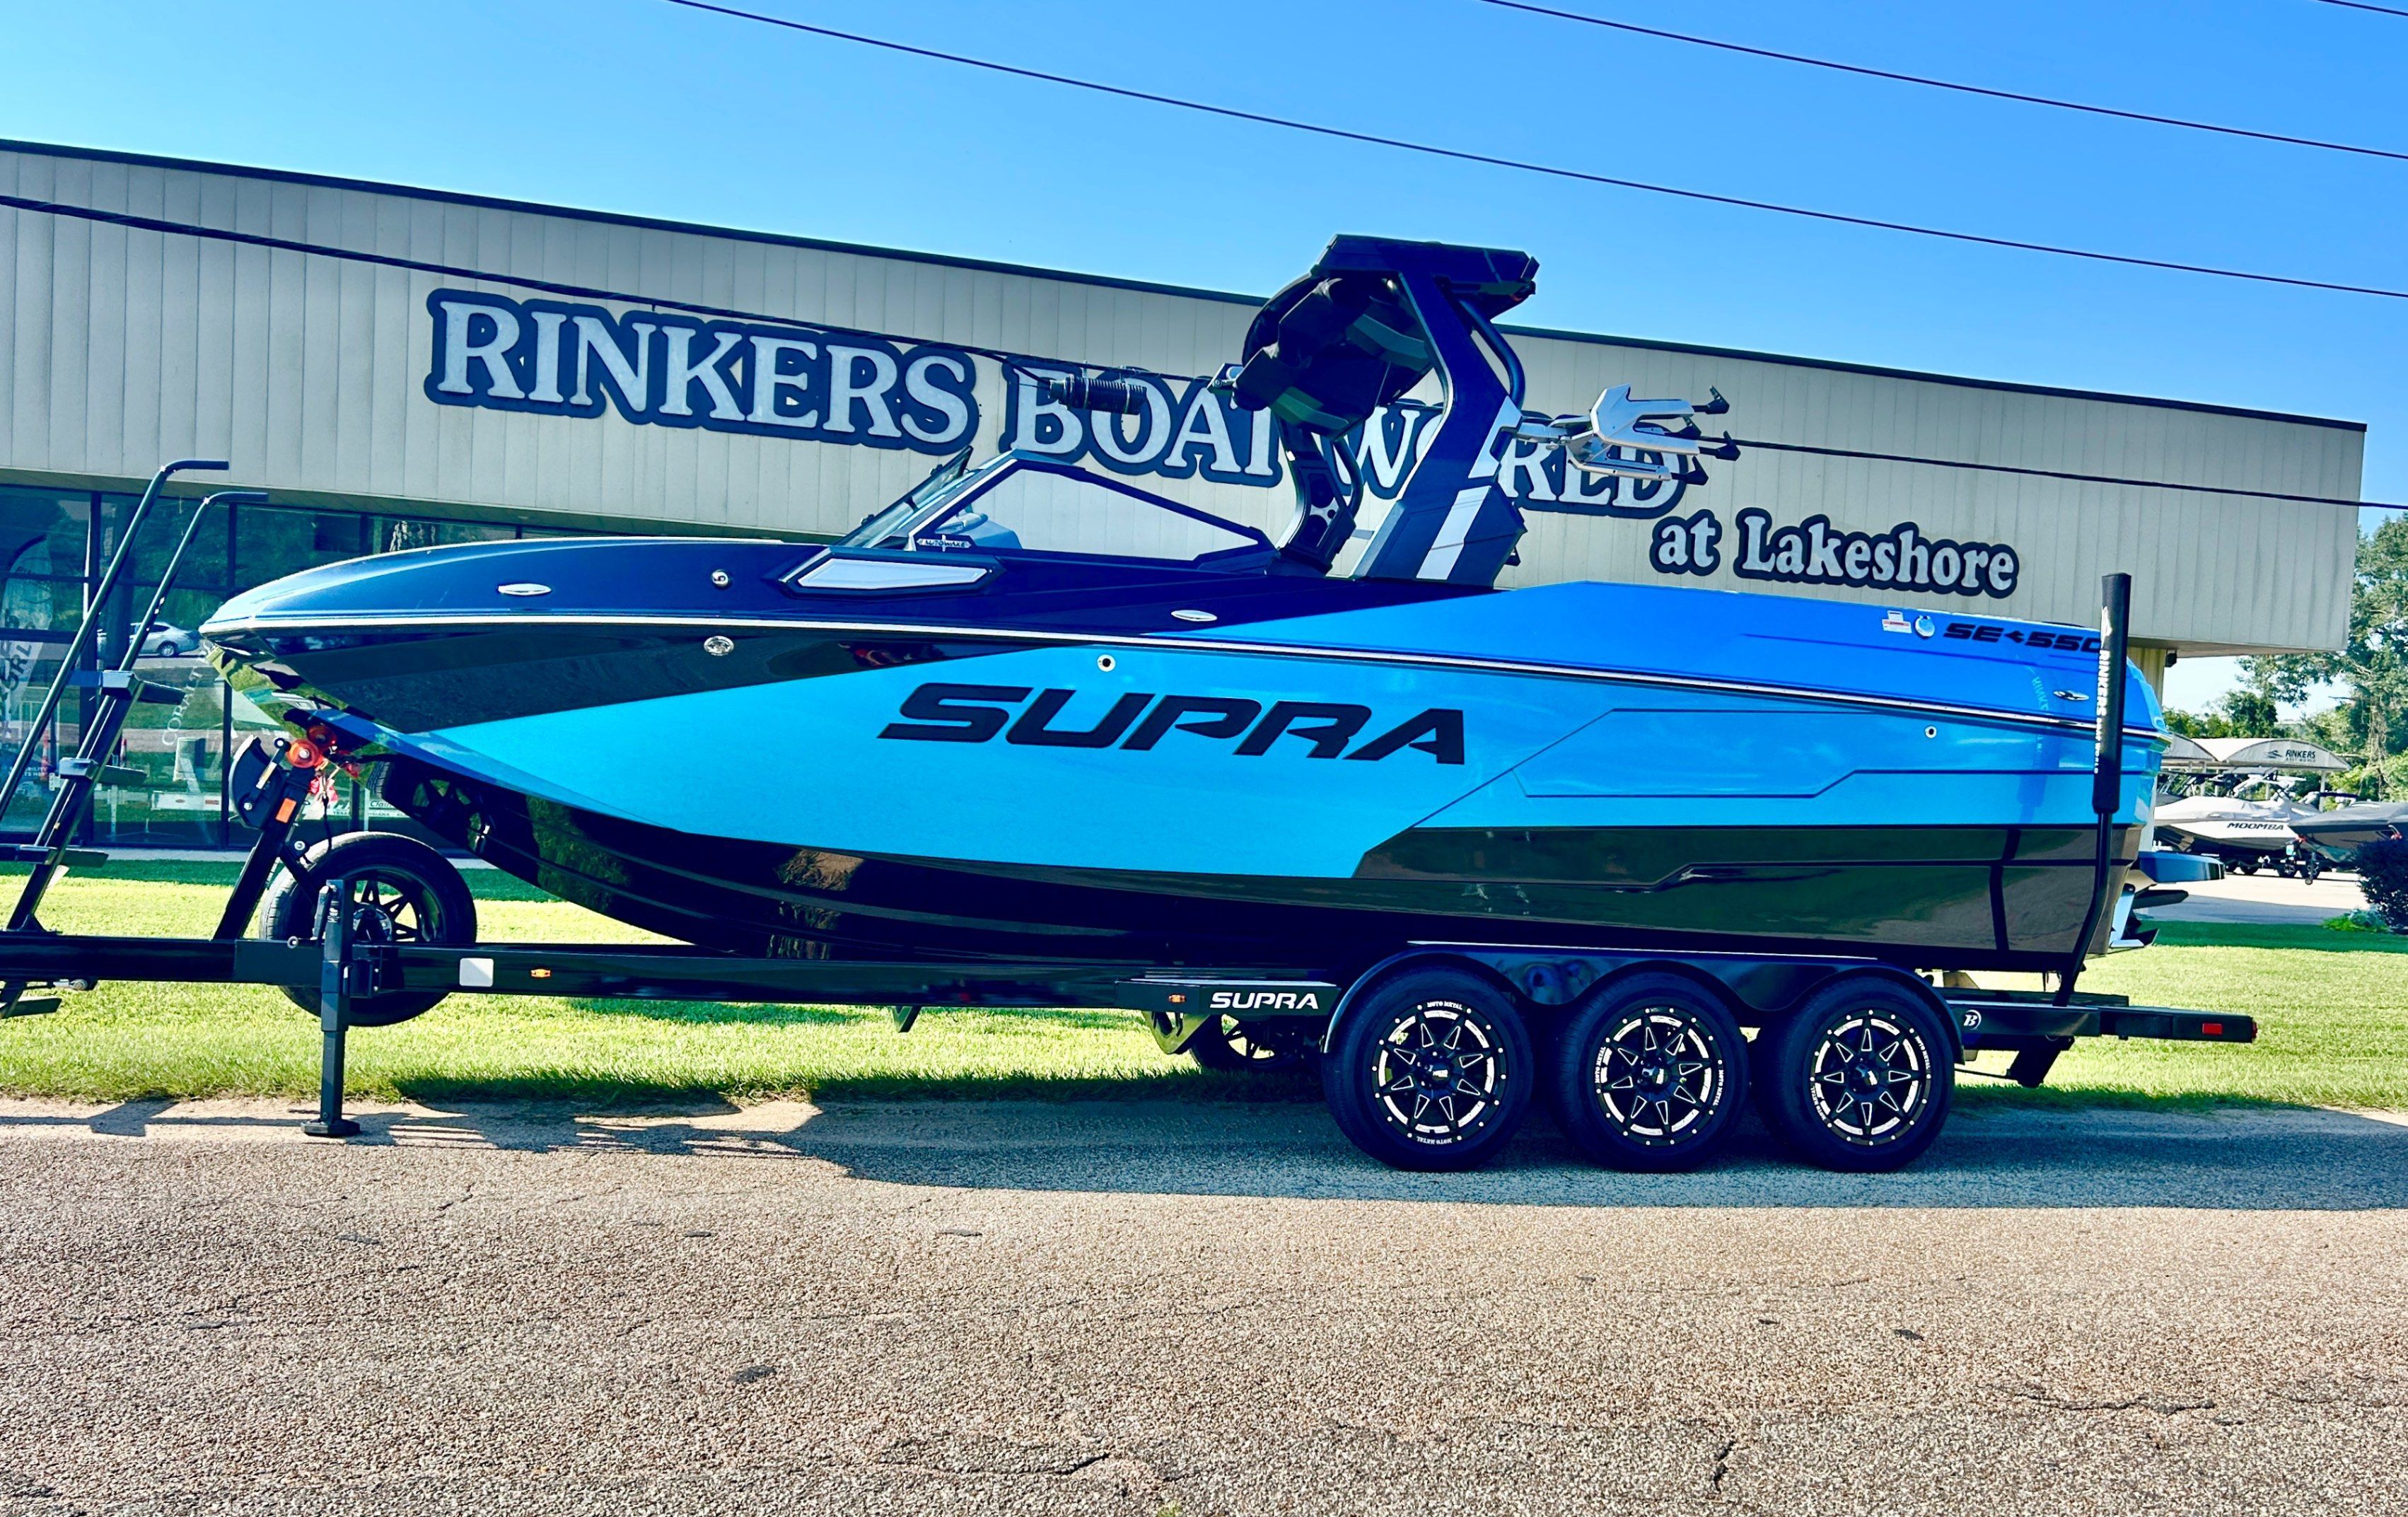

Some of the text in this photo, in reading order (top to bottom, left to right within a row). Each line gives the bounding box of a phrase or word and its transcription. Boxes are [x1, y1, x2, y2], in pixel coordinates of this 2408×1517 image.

[436, 300, 973, 446] RINKERS
[1331, 405, 1679, 508] WRLD
[1658, 514, 2015, 591] at Lakeshore
[2095, 649, 2111, 717] RINKERS
[876, 682, 1465, 765] SUPRA
[2285, 749, 2316, 759] RINKERS
[2226, 822, 2284, 830] MOOMBA
[1209, 992, 1319, 1010] SUPRA
[1962, 1013, 1979, 1027] B
